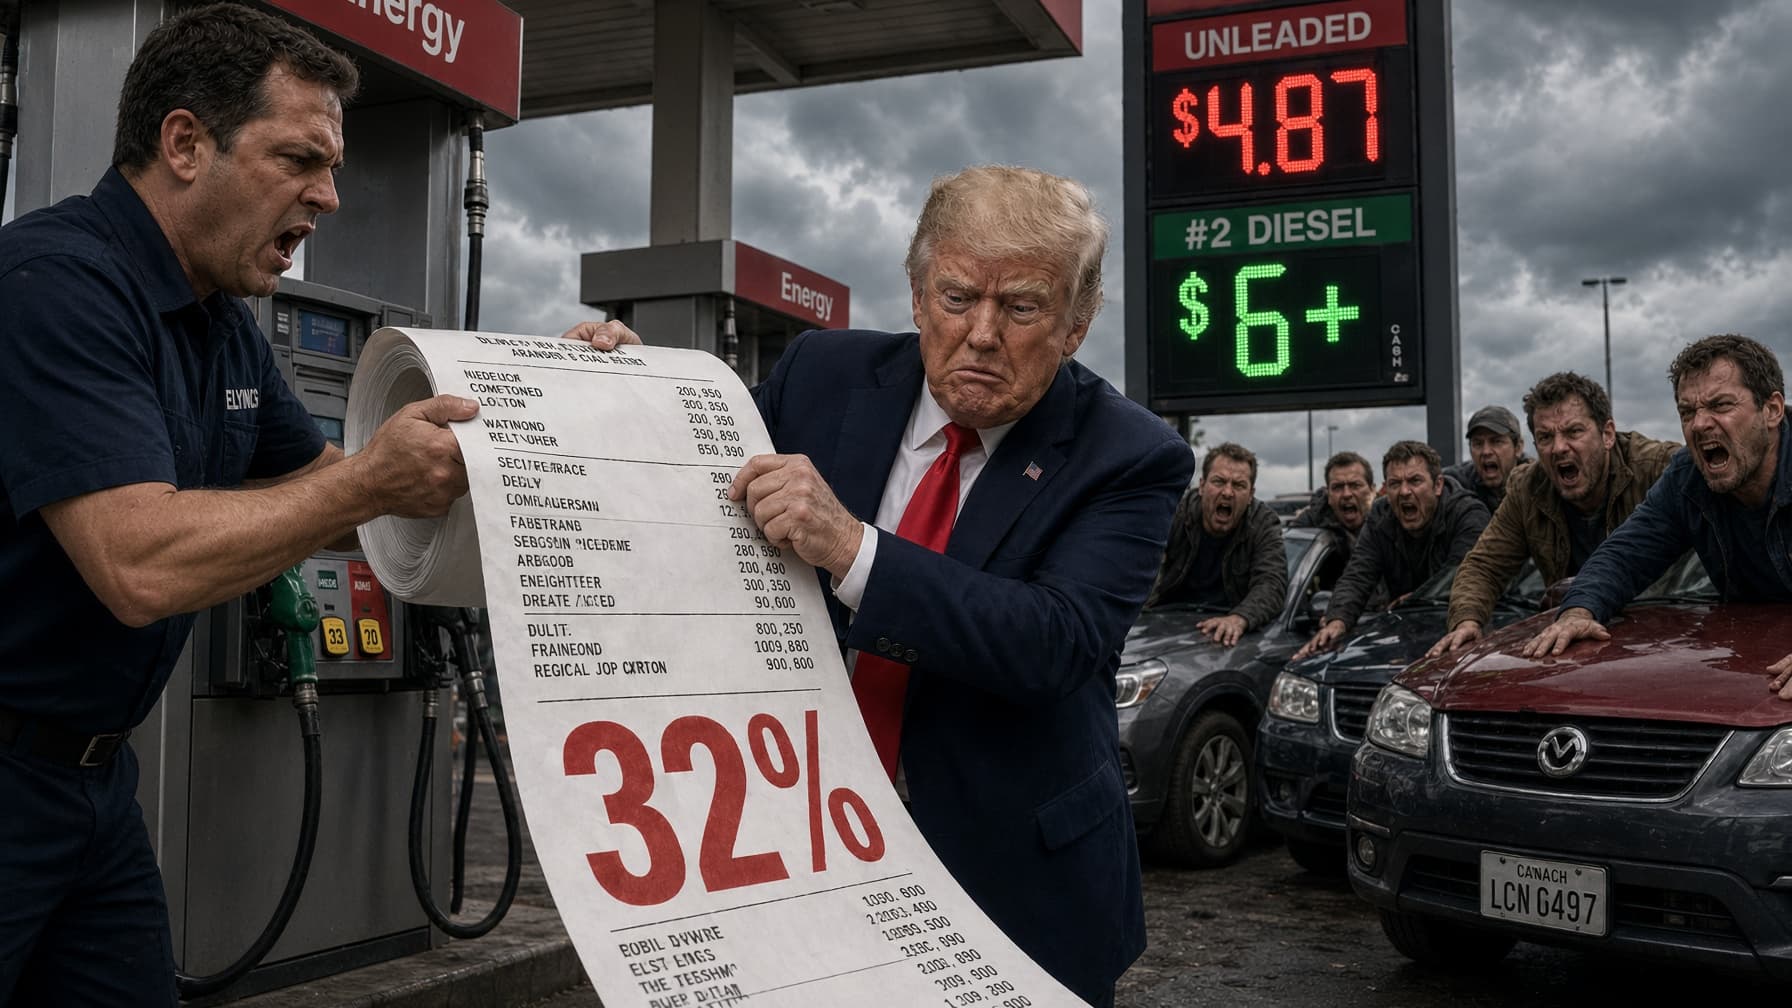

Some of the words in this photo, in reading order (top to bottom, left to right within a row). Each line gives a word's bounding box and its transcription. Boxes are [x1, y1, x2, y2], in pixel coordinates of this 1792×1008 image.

[347, 0, 465, 63] ergy
[1185, 11, 1371, 60] UNLEADED
[1172, 67, 1379, 176] $4.87
[1185, 217, 1231, 250] #2
[1248, 207, 1376, 245] DIESEL
[781, 271, 834, 322] Energy
[743, 578, 791, 593] 300,350
[754, 639, 809, 654] 1009,880
[755, 622, 803, 637] 800,250
[534, 663, 590, 678] REGICAL
[596, 662, 618, 676] JOP
[766, 657, 814, 672] 900,800
[562, 709, 886, 907] 32%
[1491, 879, 1530, 915] LCN
